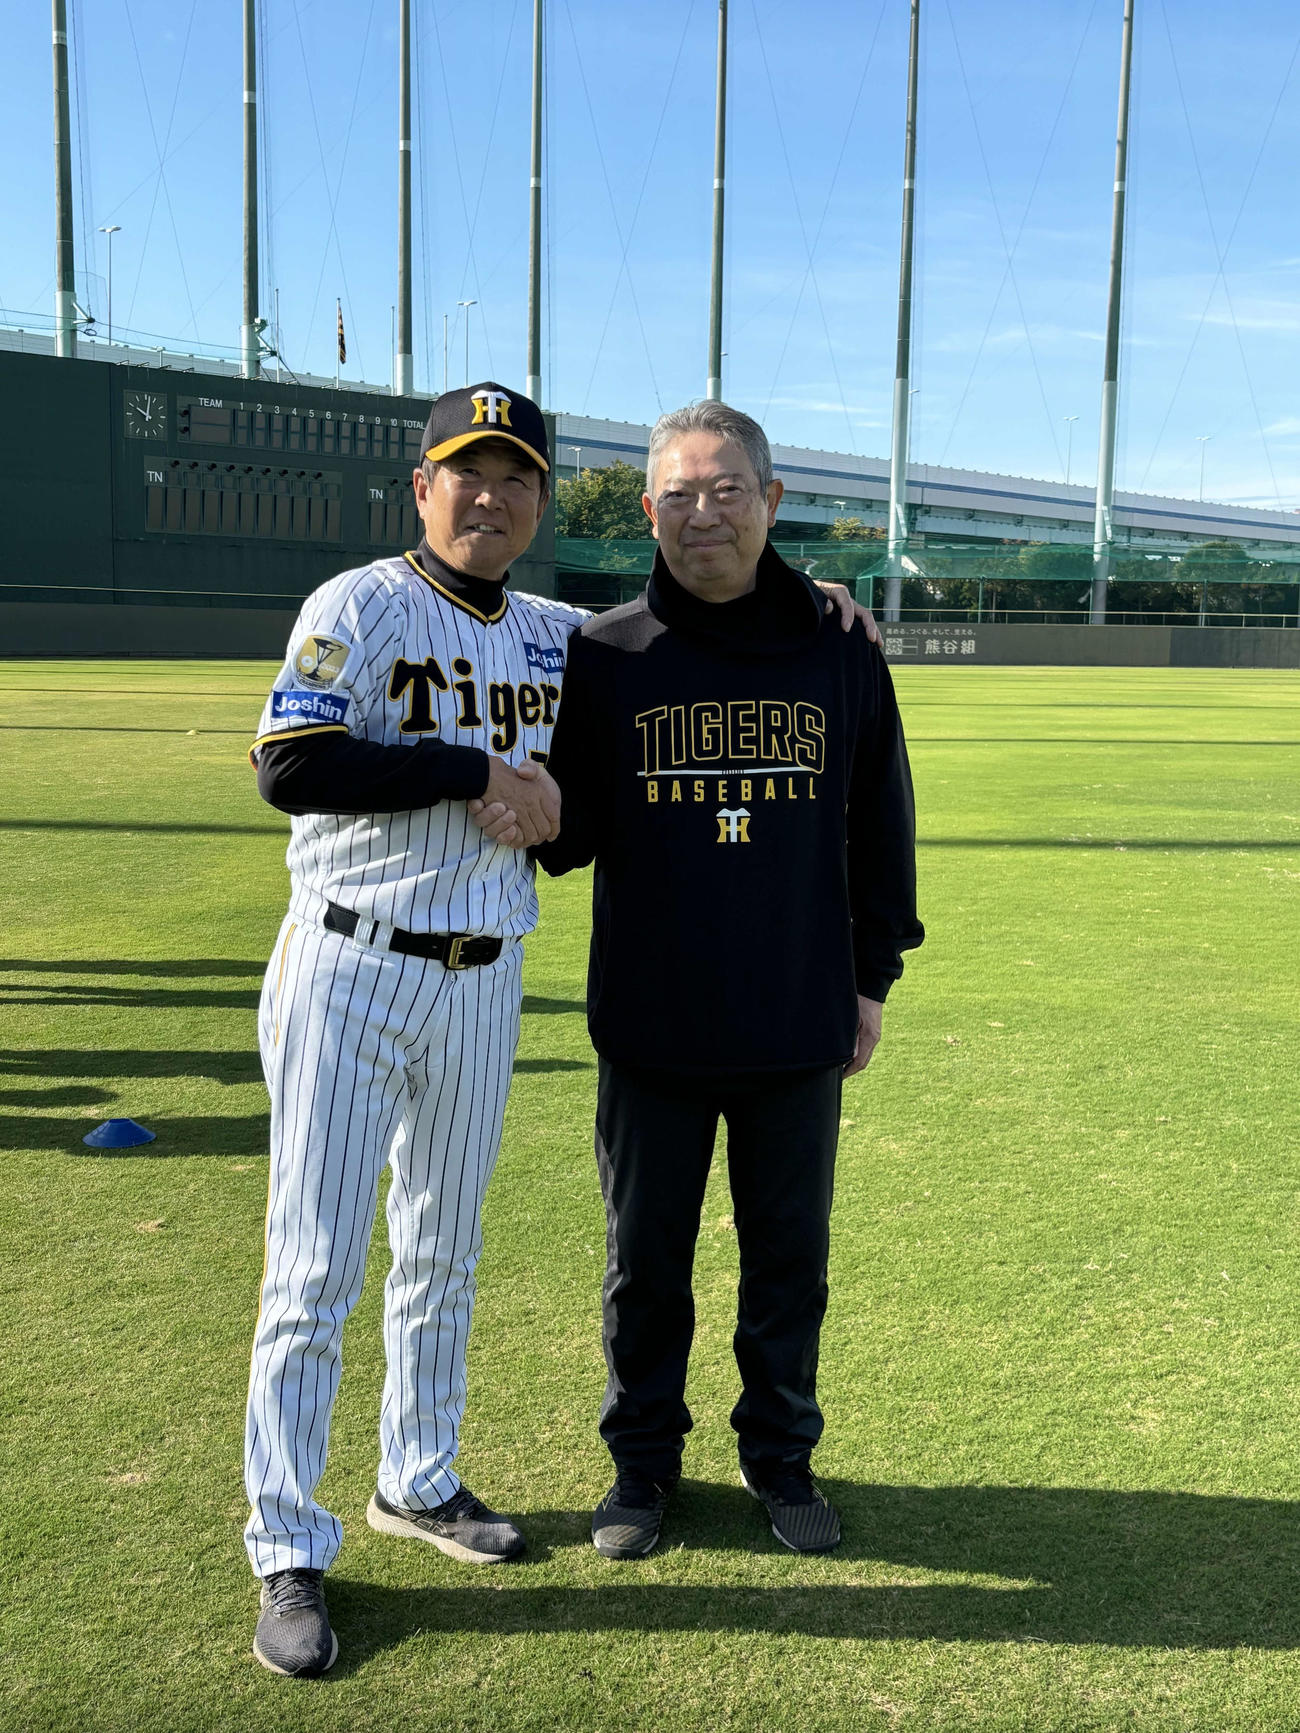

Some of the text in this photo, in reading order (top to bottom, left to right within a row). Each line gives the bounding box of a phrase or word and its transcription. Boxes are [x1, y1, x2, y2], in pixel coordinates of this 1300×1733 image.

[198, 397, 425, 430] TEAM 1 2 3 4 5 6 7 8 9 10 TOTAL
[147, 470, 163, 483] TN
[369, 488, 383, 500] TN
[924, 639, 976, 655] 熊谷組
[274, 695, 343, 721] Joshin
[635, 700, 826, 778] TIGERS
[647, 777, 817, 803] BASEBALL
